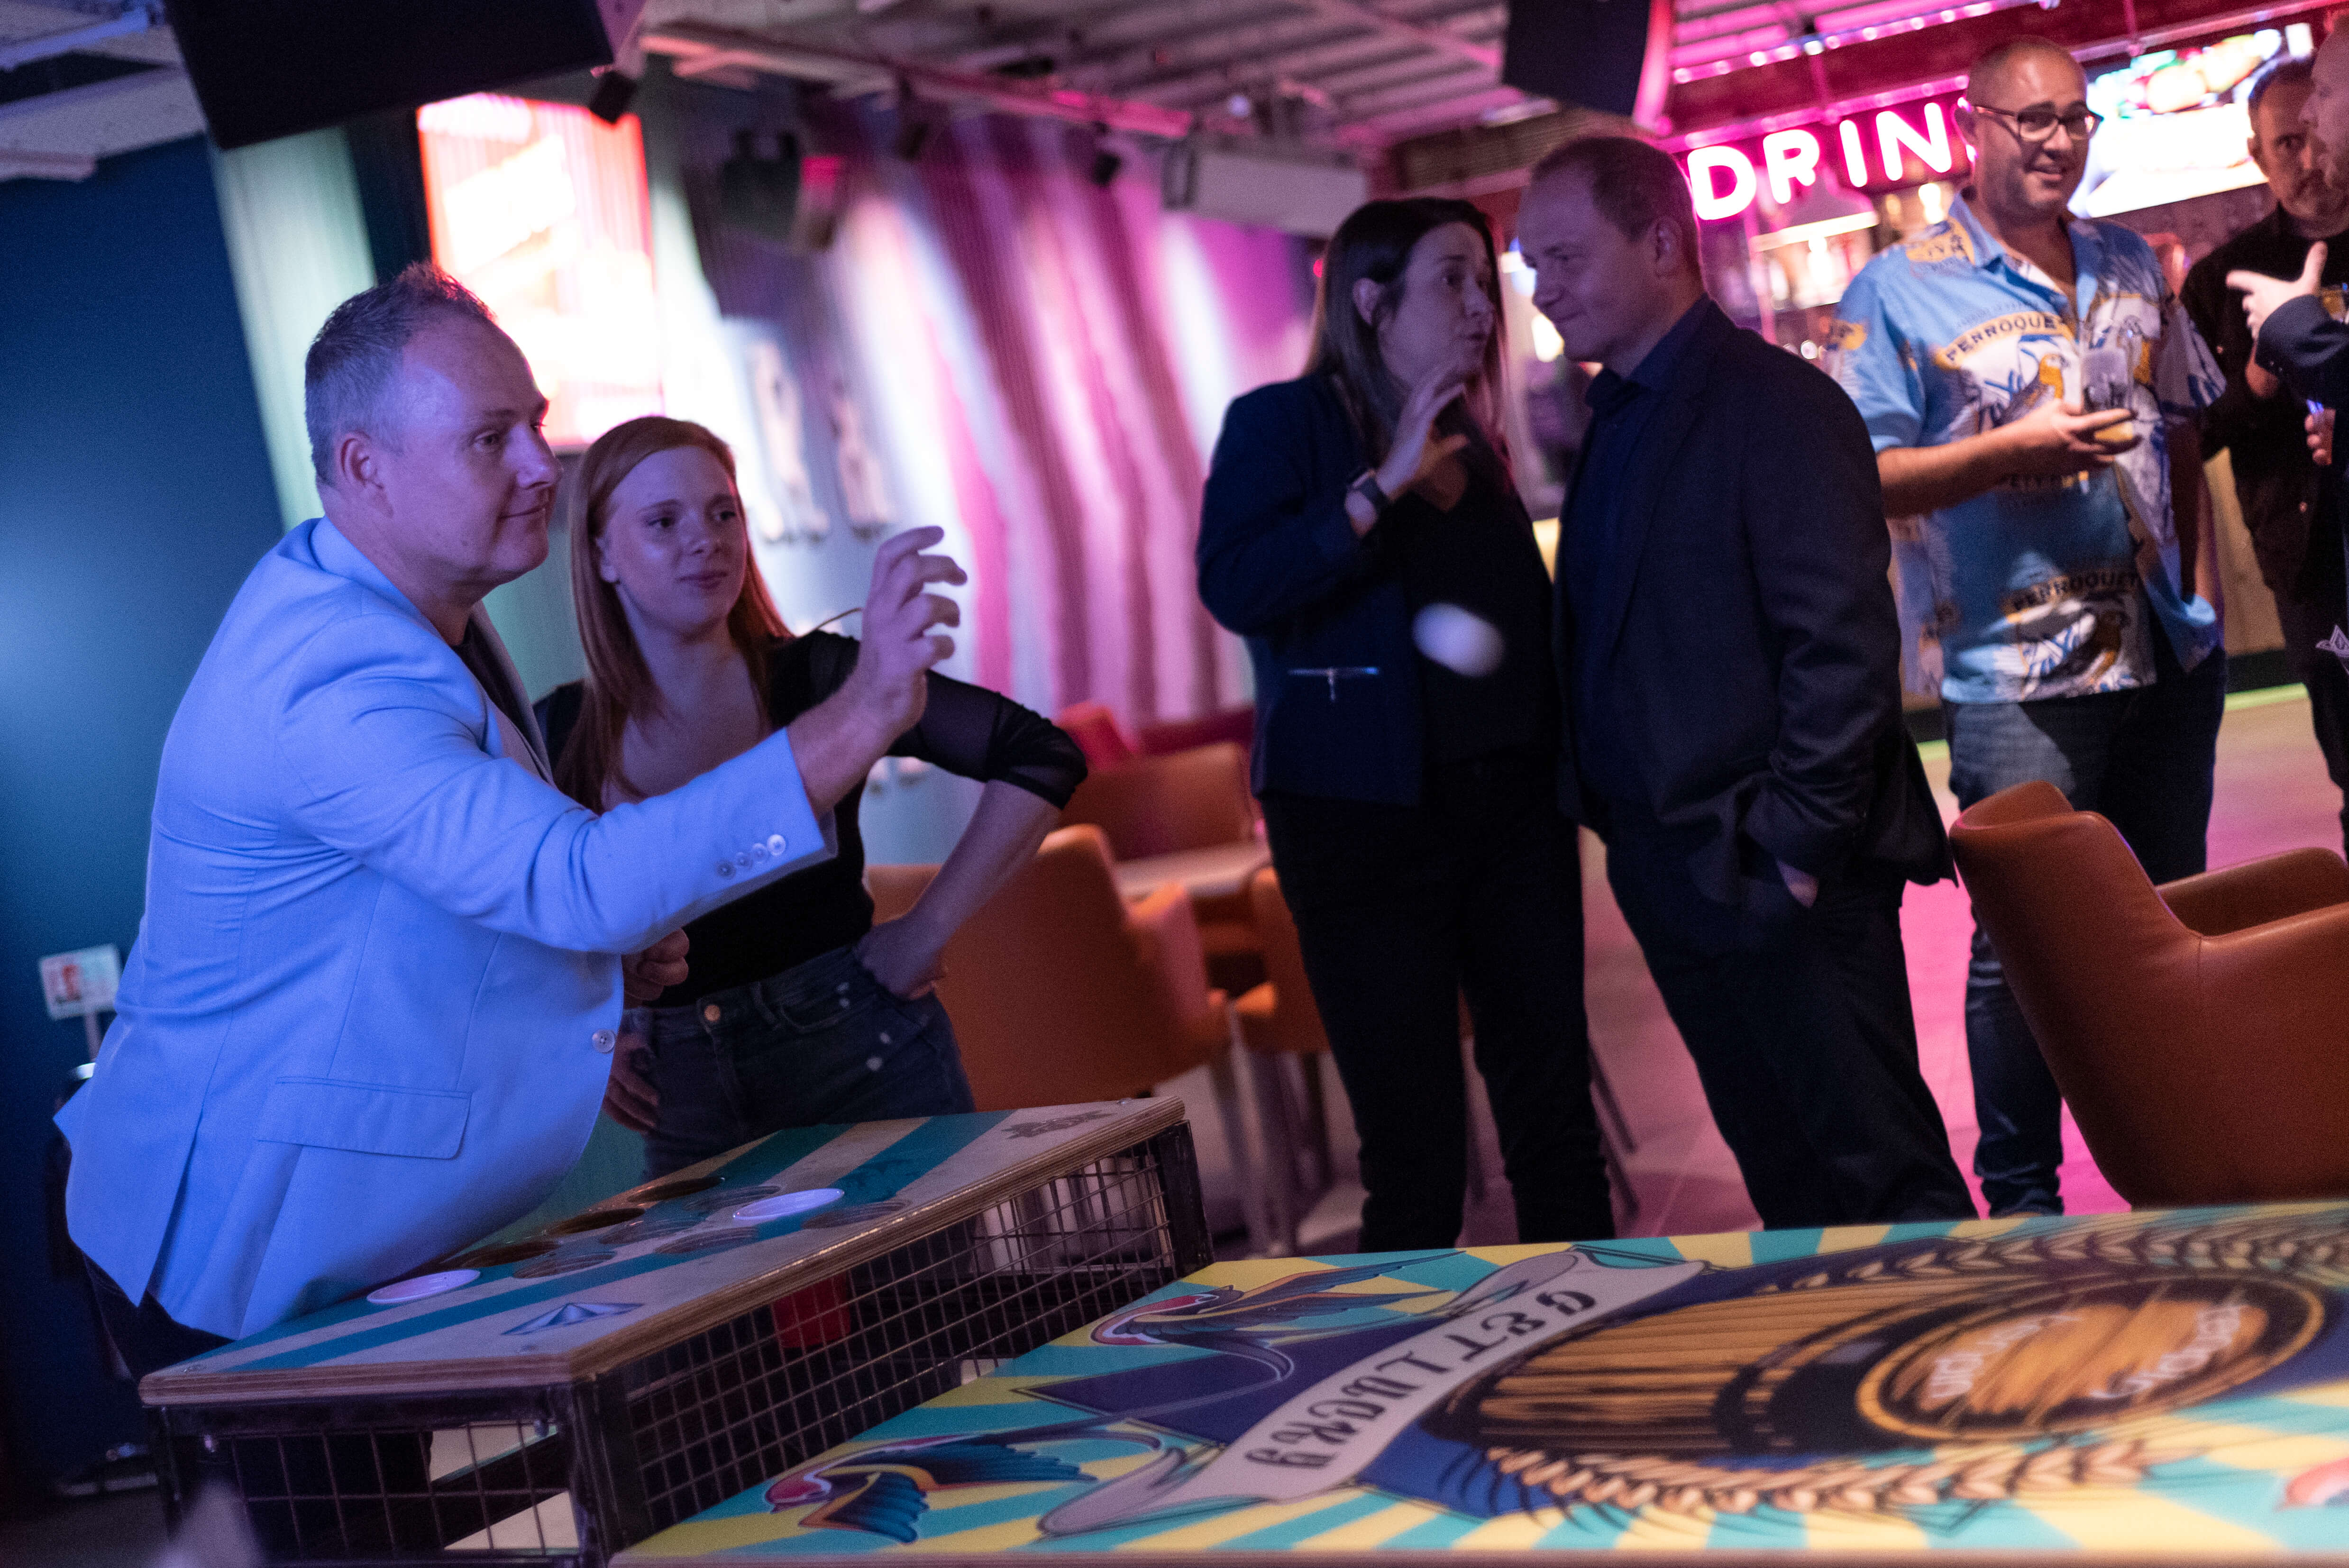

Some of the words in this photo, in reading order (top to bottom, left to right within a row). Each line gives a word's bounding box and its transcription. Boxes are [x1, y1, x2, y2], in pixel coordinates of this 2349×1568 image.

[1687, 97, 1977, 221] DRIN
[1946, 314, 2057, 362] PERROQUE
[1444, 1289, 1597, 1362] GET
